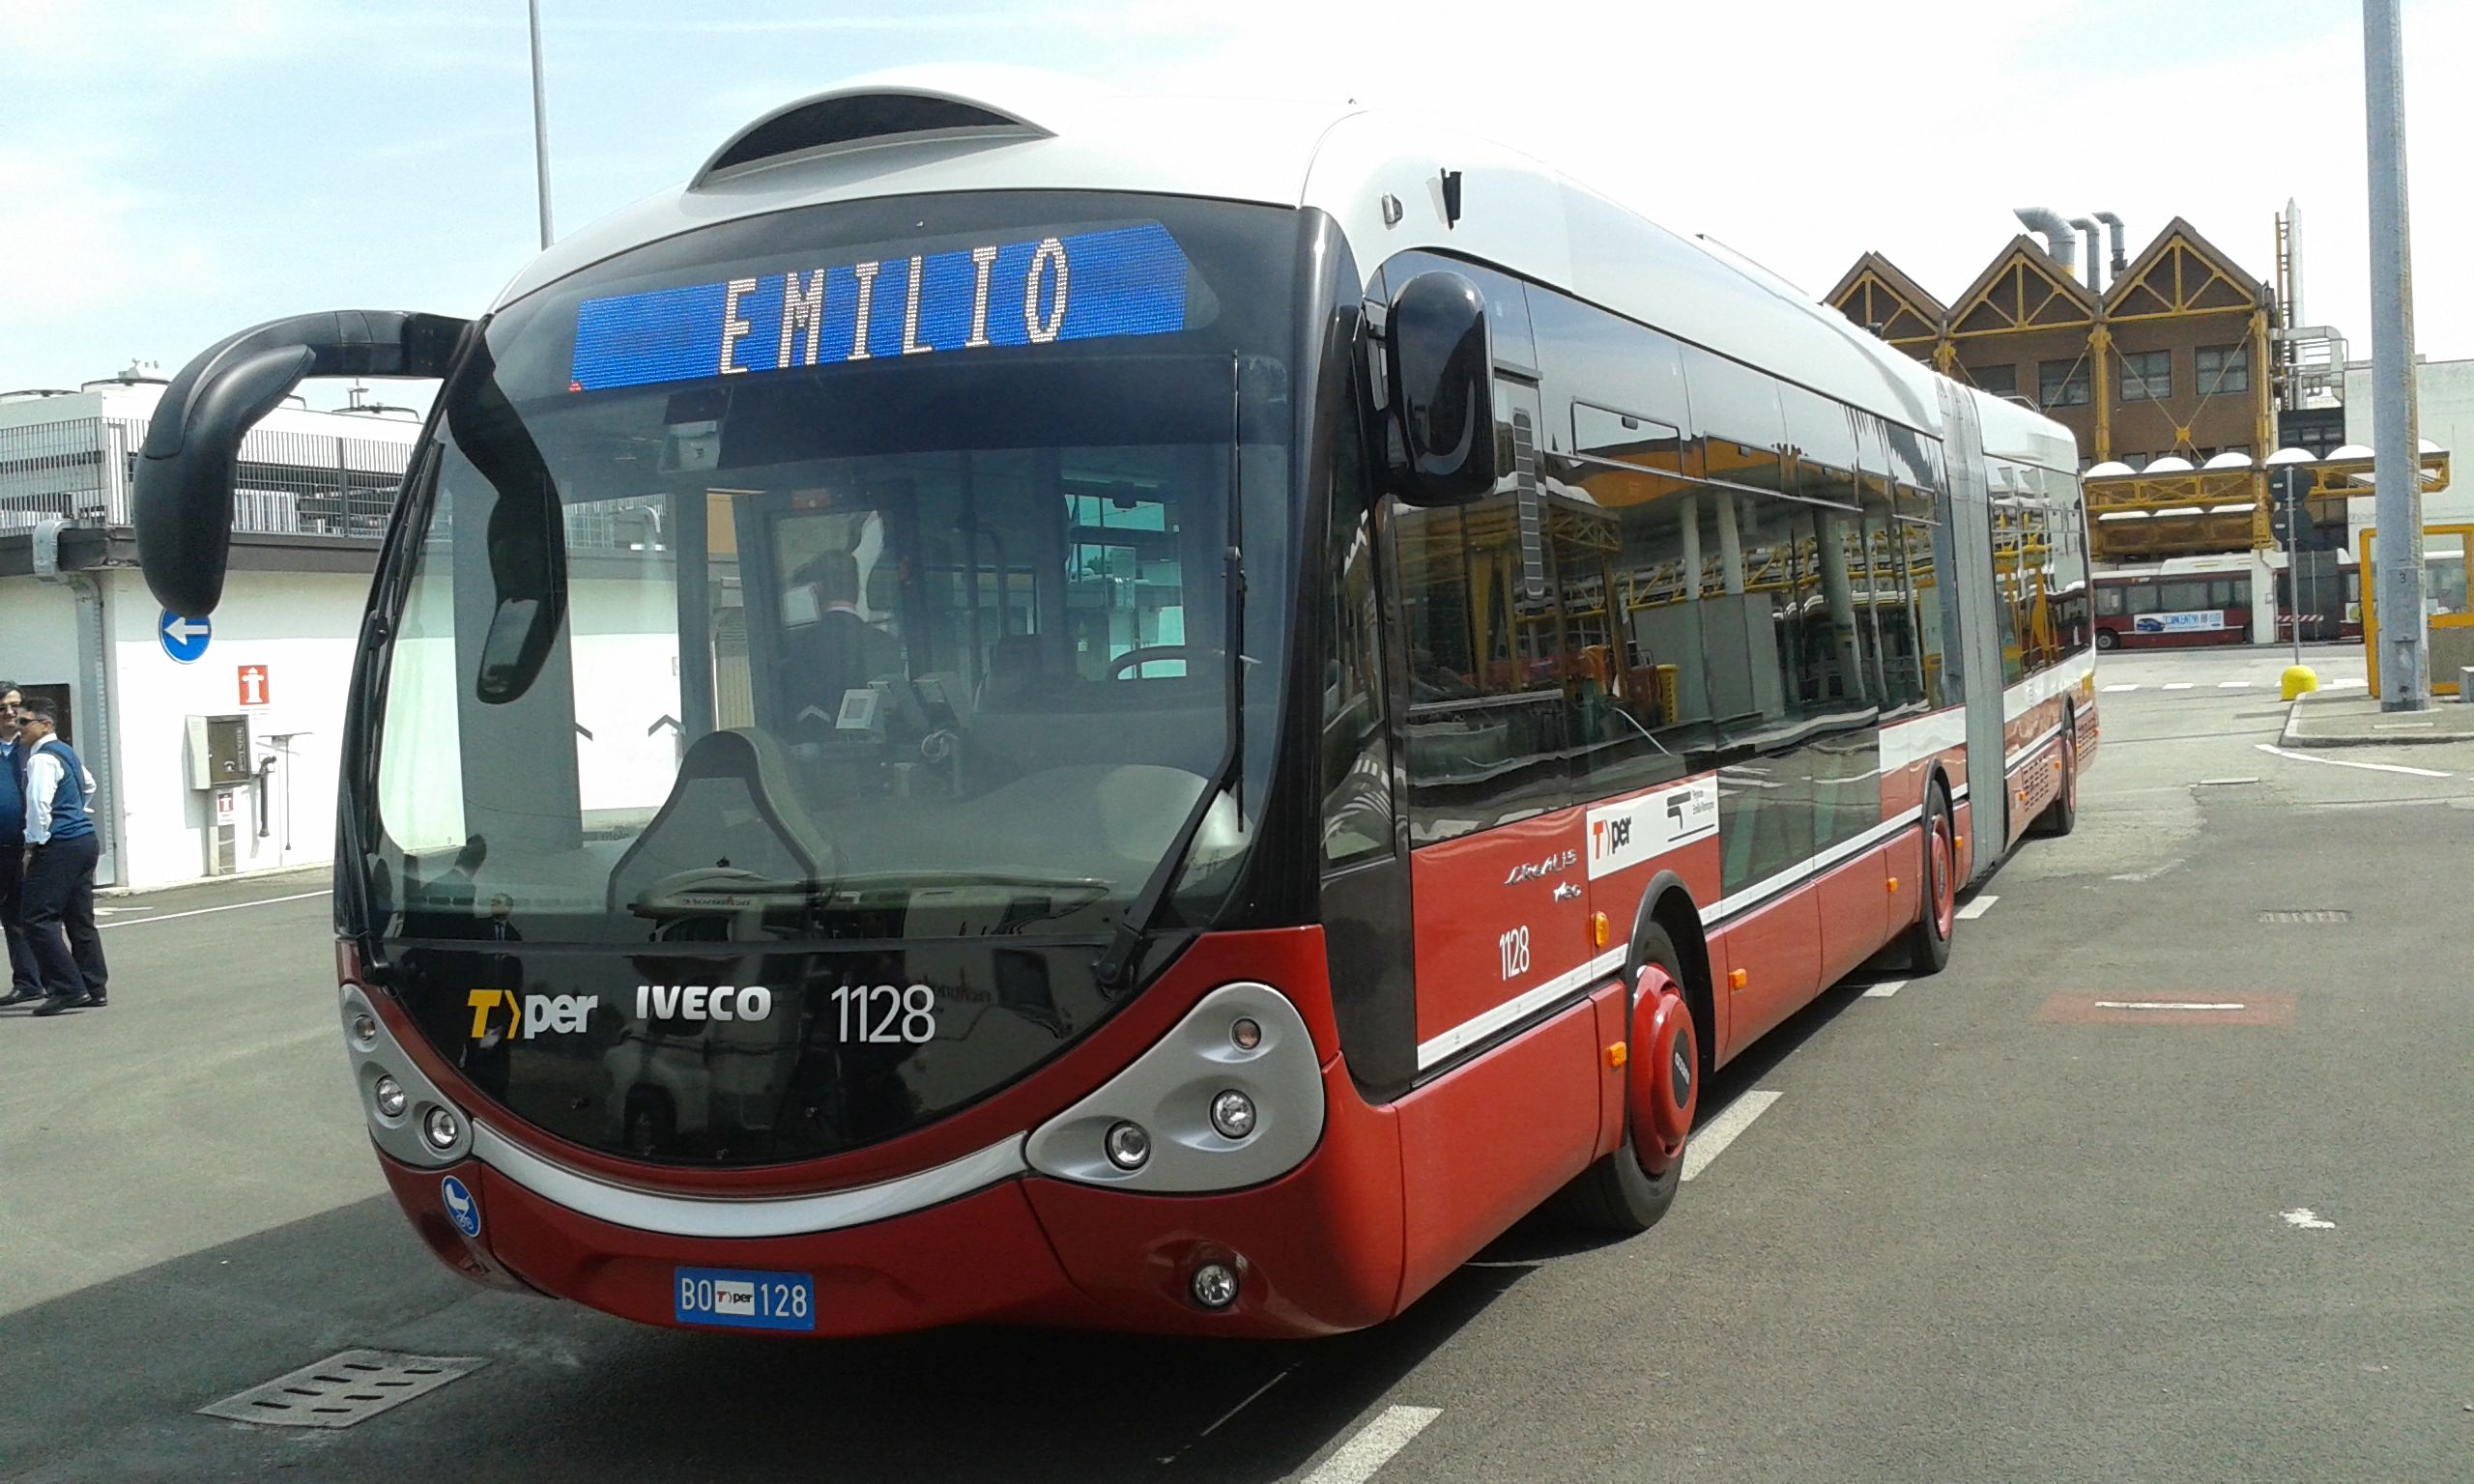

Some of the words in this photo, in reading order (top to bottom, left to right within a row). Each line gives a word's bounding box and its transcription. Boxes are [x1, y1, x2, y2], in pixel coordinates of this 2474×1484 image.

[719, 237, 1069, 375] EMILIO
[1499, 925, 1530, 982] 1128
[635, 985, 772, 1022] IVECO
[831, 984, 936, 1043] 1128
[681, 1277, 712, 1312] BO
[761, 1283, 808, 1318] 128
